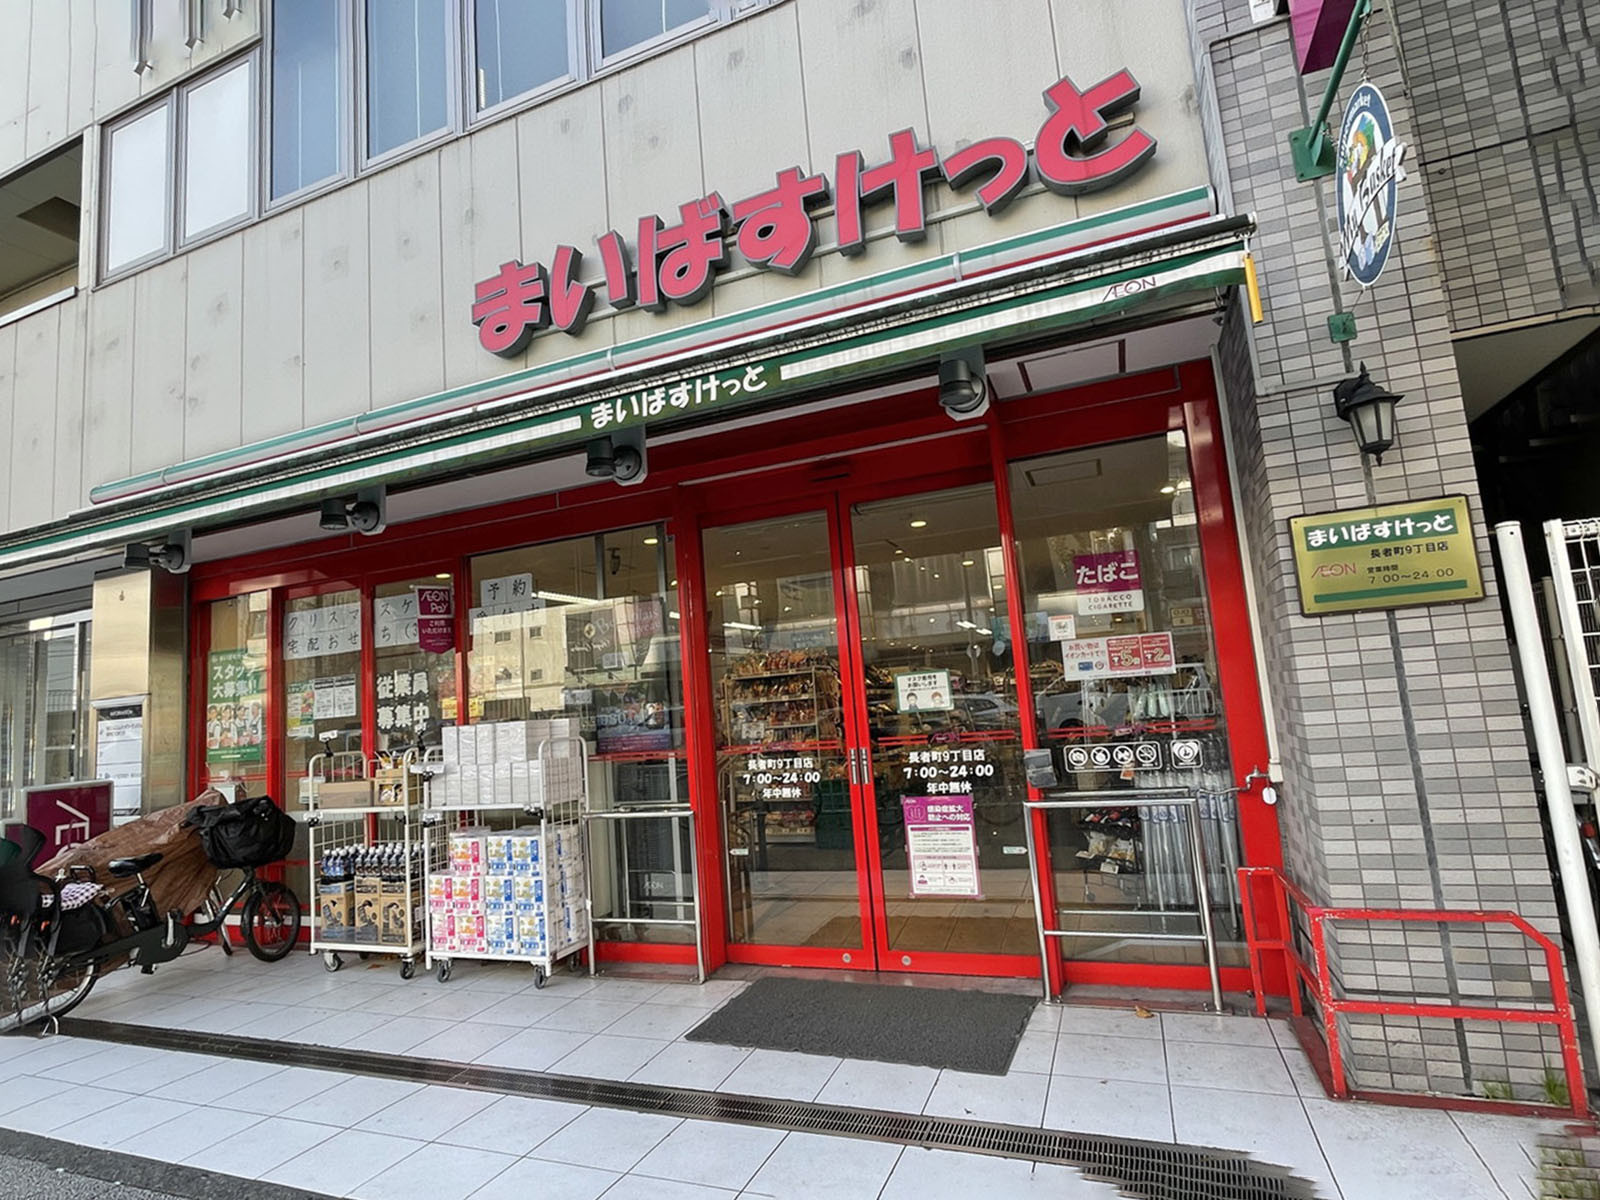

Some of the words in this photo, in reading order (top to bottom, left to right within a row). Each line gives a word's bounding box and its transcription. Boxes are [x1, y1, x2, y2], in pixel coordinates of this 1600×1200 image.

[471, 69, 1157, 357] まいばすけっと
[591, 365, 768, 429] まいばすけっと
[1307, 514, 1454, 547] まいばすけっと
[1370, 541, 1449, 558] 長者町9丁目店
[1075, 562, 1139, 585] たばこ
[487, 579, 526, 600] 予約
[1088, 593, 1133, 603] TOBACCO
[1087, 601, 1133, 611] CIGARETTE
[376, 671, 429, 700] 従業員
[748, 757, 814, 771] 長者町9丁目店
[908, 749, 986, 764] 長者町9丁目店
[762, 787, 802, 799] 年中無休
[926, 781, 972, 794] 年中無休
